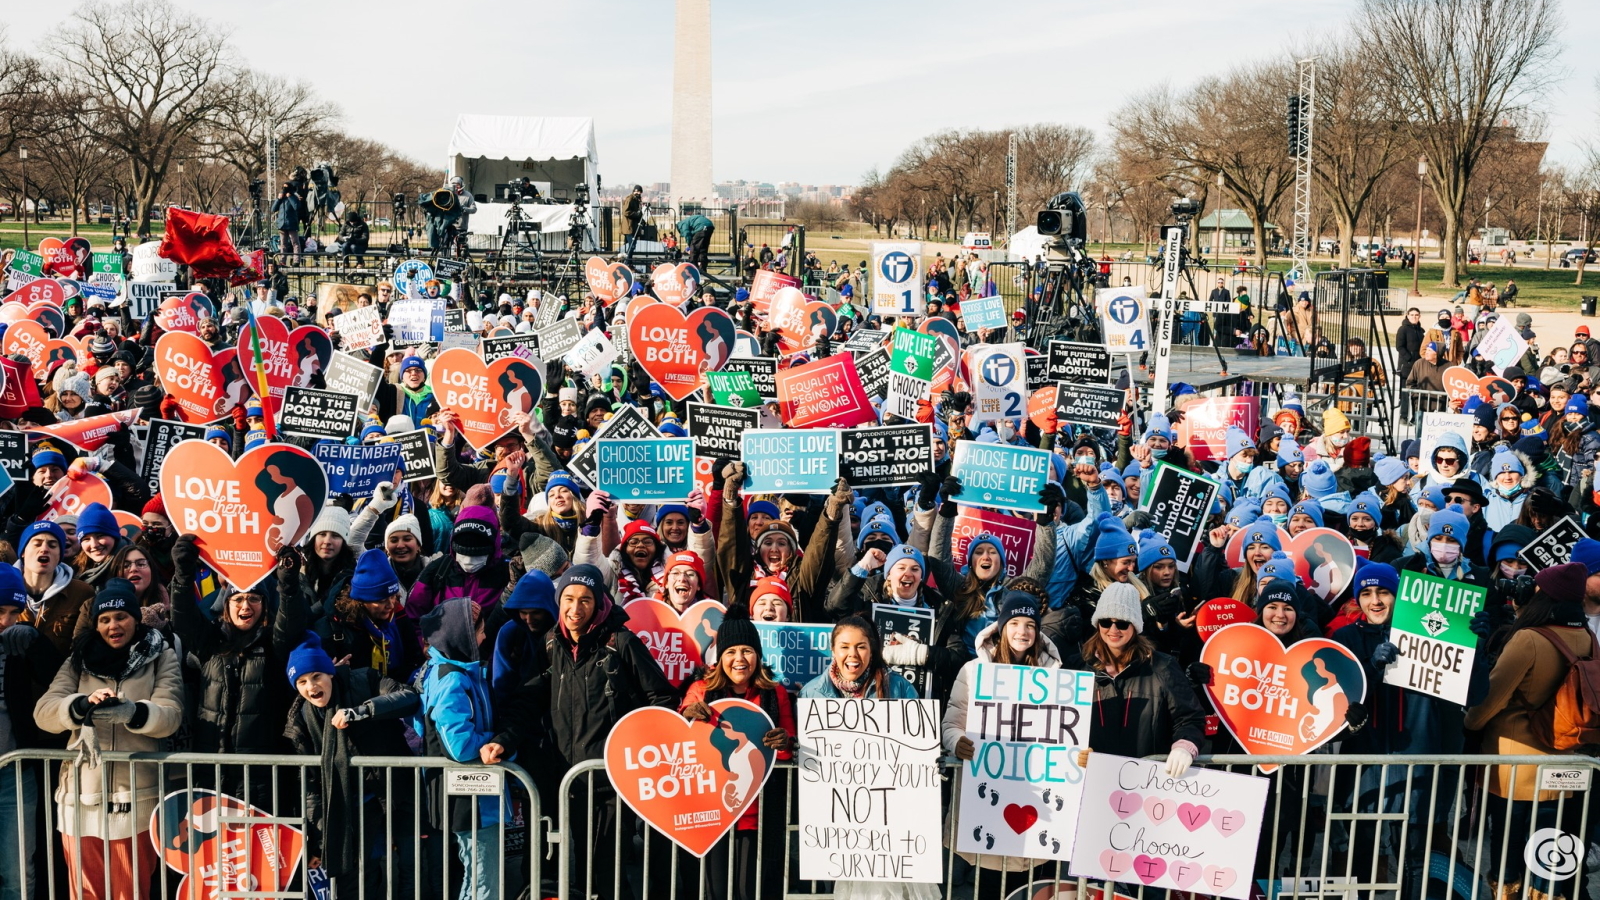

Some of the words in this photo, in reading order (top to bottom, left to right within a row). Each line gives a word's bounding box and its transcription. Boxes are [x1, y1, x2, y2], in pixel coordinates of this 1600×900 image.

[30, 255, 43, 267] LIFE
[95, 254, 112, 264] LOVE
[112, 254, 121, 264] LIFE
[1167, 232, 1178, 282] JESUS
[590, 266, 608, 279] LOVE
[592, 278, 612, 290] BOTH
[902, 290, 914, 312] 1
[963, 302, 983, 312] CHOOSE
[984, 300, 1001, 310] LOVE
[1205, 302, 1230, 312] HIM
[168, 316, 195, 329] BOTH
[986, 310, 1000, 320] LIFE
[1162, 290, 1172, 340] LOVES
[14, 328, 47, 353] LOVE
[402, 330, 424, 340] KILLED
[543, 333, 568, 348] ANTI-
[641, 326, 688, 344] LOVE
[1130, 329, 1146, 350] 4
[248, 338, 290, 358] LOVE
[496, 343, 512, 351] AM
[894, 332, 914, 353] LOVE
[915, 337, 934, 359] LIFE
[1070, 350, 1098, 359] FUTURE
[1160, 347, 1167, 357] U
[165, 348, 212, 379] LOVE
[646, 346, 698, 365] BOTH
[866, 354, 886, 370] THE
[1064, 357, 1094, 368] ANTI-
[664, 372, 678, 381] LIVE
[750, 365, 772, 374] THE
[1050, 364, 1108, 378] ABORTION
[166, 368, 218, 400] BOTH
[338, 372, 364, 388] ANTI-
[442, 368, 490, 392] LOVE
[709, 374, 733, 392] LOVE
[730, 374, 754, 392] LIFE
[790, 372, 840, 394] EQUALITY
[892, 375, 927, 400] CHOOSE
[1449, 376, 1480, 393] LOVE
[326, 377, 372, 403] ABORTION
[793, 389, 830, 406] BEGINS
[832, 384, 845, 394] IN
[1080, 392, 1110, 402] FUTURE
[1111, 396, 1118, 404] IS
[179, 398, 192, 410] LIVE
[290, 394, 294, 402] I
[300, 396, 320, 406] AM
[326, 398, 352, 410] THE
[446, 390, 498, 413] BOTH
[808, 394, 850, 415] WOMB
[898, 396, 914, 419] LIFE
[982, 404, 1001, 413] LIFE
[1004, 392, 1022, 416] 2
[1041, 396, 1054, 404] FOR
[1072, 398, 1106, 410] ANTI-
[284, 404, 355, 421] POST-ROE
[694, 414, 710, 424] THE
[712, 416, 742, 428] FUTURE
[744, 420, 752, 428] IS
[1056, 405, 1122, 420] ABORTION
[1426, 415, 1466, 428] Women
[284, 416, 350, 432] GENERATION
[464, 420, 478, 429] LIVE
[706, 424, 741, 438] ANTI-
[862, 428, 917, 438] STUDENTSFORLIFE.ORG
[82, 428, 97, 440] LIVE
[847, 439, 852, 450] I
[860, 438, 886, 449] AM
[892, 436, 924, 446] THE
[319, 445, 400, 460] REMEMBER
[415, 440, 423, 448] IS
[602, 444, 652, 463] CHOOSE
[656, 444, 690, 462] LOVE
[746, 436, 795, 455] CHOOSE
[800, 436, 834, 452] LOVE
[148, 425, 170, 497] GENERATION
[844, 446, 930, 465] POST-ROE
[960, 448, 1010, 469] CHOOSE
[1012, 453, 1046, 474] LOVE
[320, 462, 345, 476] The
[350, 462, 394, 477] Unborn
[602, 466, 652, 485] CHOOSE
[656, 466, 684, 484] LIFE
[747, 458, 795, 476] CHOOSE
[800, 458, 828, 475] LIFE
[174, 474, 241, 504] LOVE
[342, 480, 356, 488] Jer
[358, 478, 371, 487] 1:5
[956, 468, 1006, 491] CHOOSE
[1010, 474, 1039, 495] LIFE
[200, 494, 250, 515] them
[184, 508, 260, 535] BOTH
[1176, 496, 1202, 536] LIFE
[215, 550, 234, 561] LIVE
[234, 550, 263, 562] ACTION
[1401, 576, 1444, 609] LOVE
[1444, 586, 1482, 618] LIFE
[1198, 624, 1222, 632] EVERY
[647, 644, 688, 664] them
[1398, 634, 1464, 674] CHOOSE
[1218, 652, 1288, 686] LOVE
[1054, 670, 1094, 706] BE
[1246, 673, 1292, 700] them
[1408, 663, 1443, 696] LIFE
[1223, 684, 1298, 720] BOTH
[804, 698, 938, 740] ABORTION
[974, 702, 1080, 746] THEIR
[1249, 726, 1267, 740] LIVE
[1266, 729, 1294, 746] ACTION
[624, 740, 698, 771] LOVE
[808, 736, 842, 758] The
[853, 737, 901, 769] Only
[656, 758, 707, 778] them
[802, 757, 881, 786] Surgery
[968, 742, 1084, 785] VOICES
[638, 770, 717, 801] BOTH
[1118, 760, 1220, 798] Choose
[831, 786, 897, 826] NOT
[1117, 796, 1233, 831] LOVE
[674, 813, 694, 826] LIVE
[692, 809, 721, 824] ACTION
[900, 830, 928, 855] to
[1109, 822, 1204, 859] Choose
[828, 852, 913, 879] SURVIVE
[1109, 856, 1226, 888] LIFE
